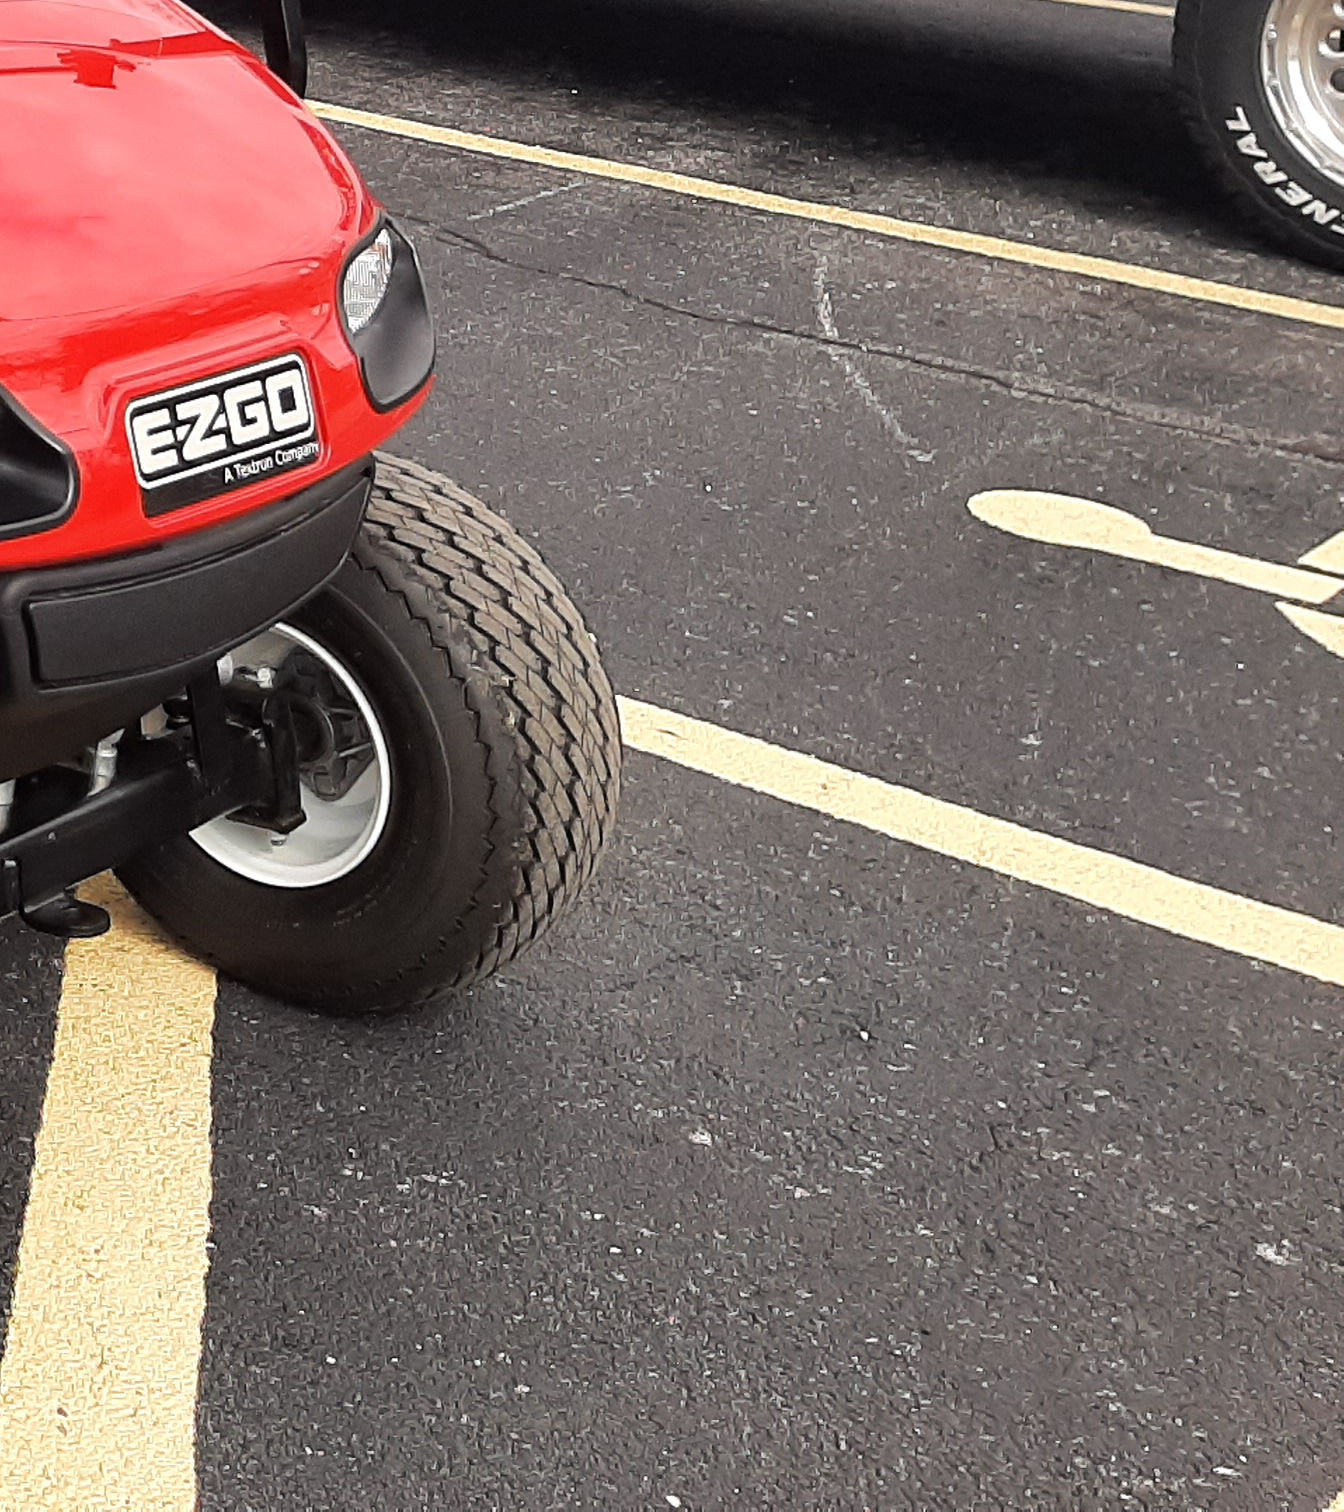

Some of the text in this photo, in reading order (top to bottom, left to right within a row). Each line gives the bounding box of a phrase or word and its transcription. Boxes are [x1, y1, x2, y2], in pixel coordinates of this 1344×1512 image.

[1225, 105, 1344, 236] NERAL
[224, 441, 320, 484] A Textron Company
